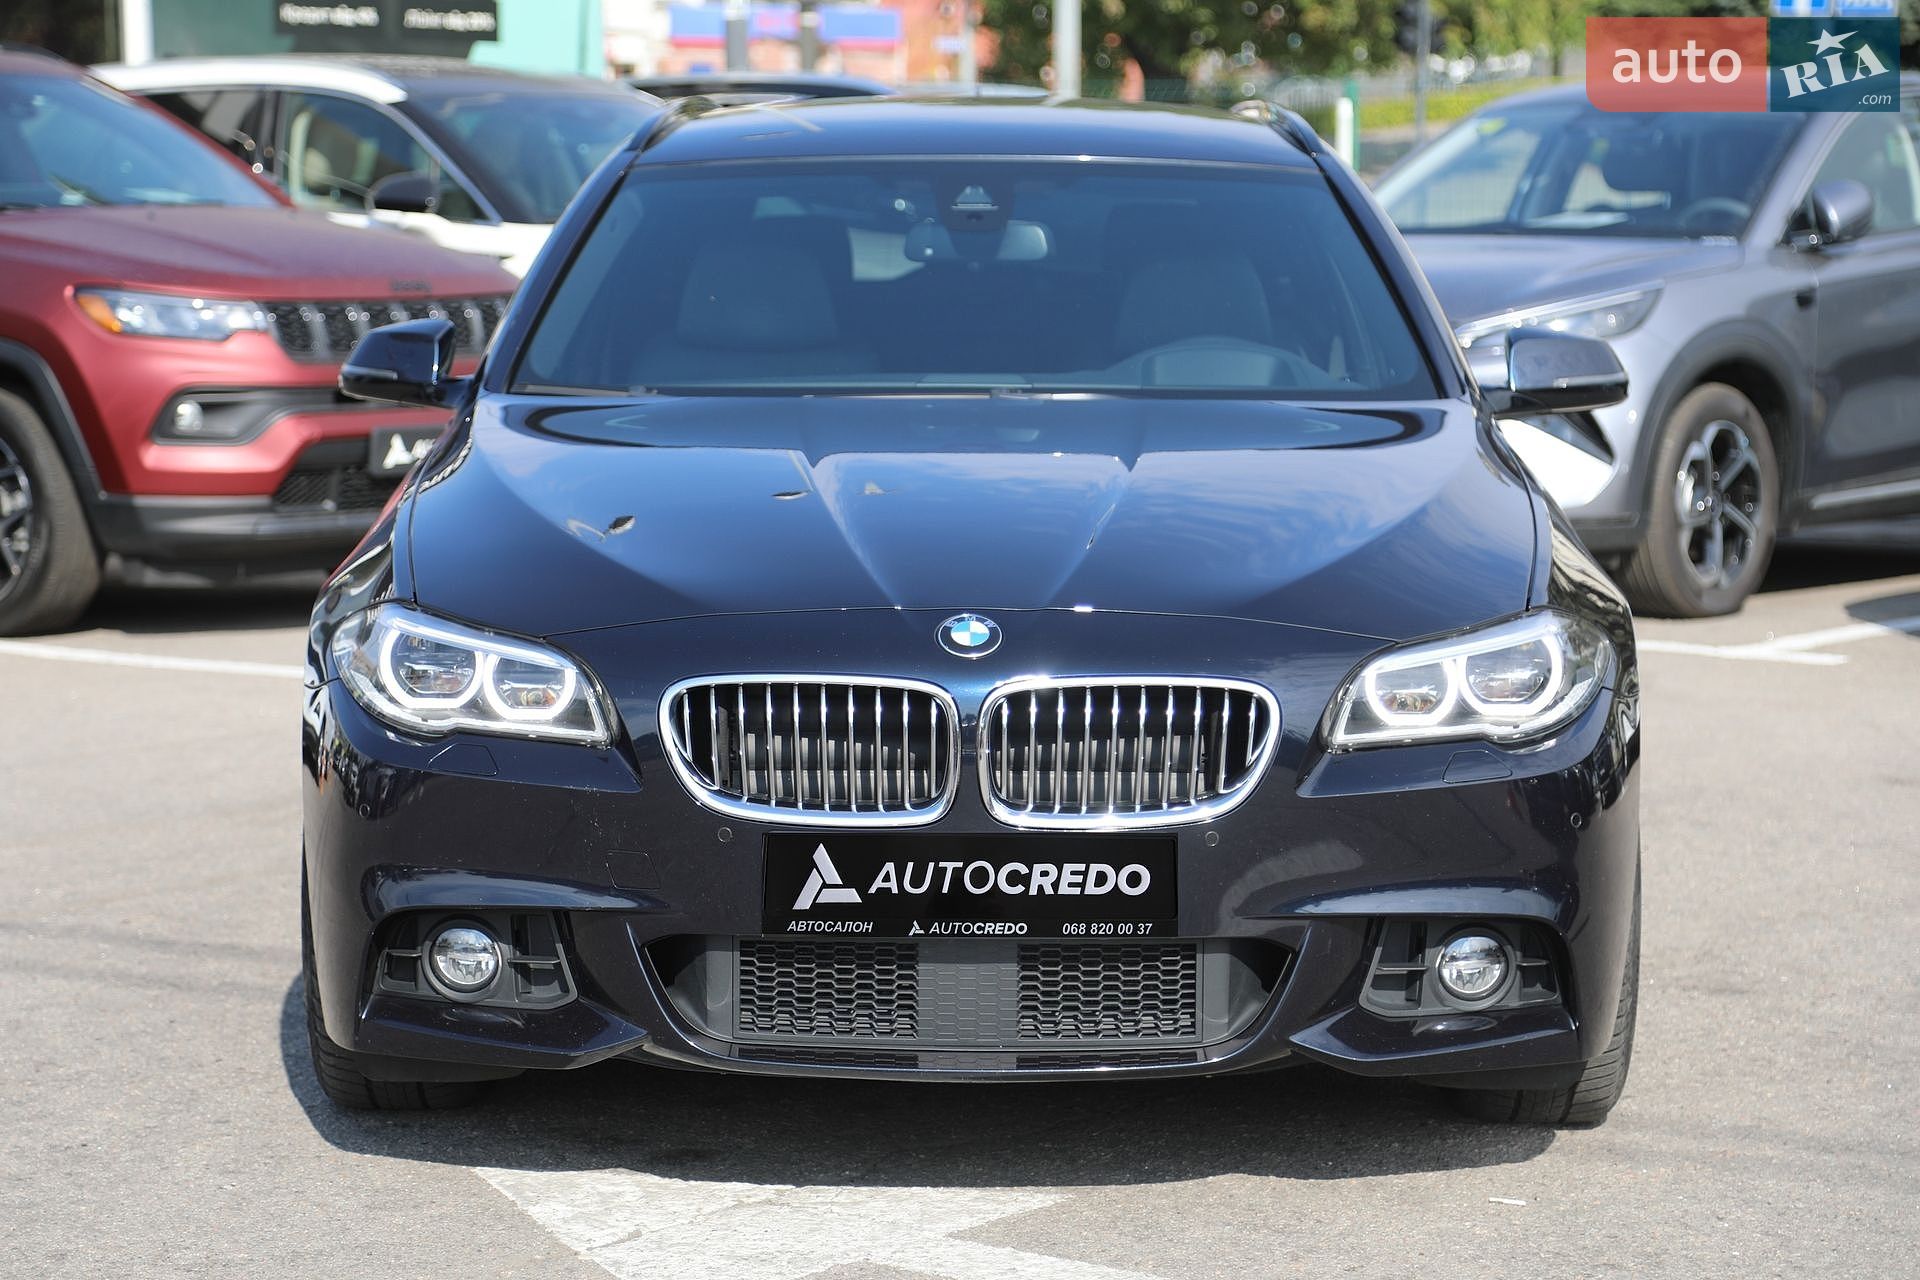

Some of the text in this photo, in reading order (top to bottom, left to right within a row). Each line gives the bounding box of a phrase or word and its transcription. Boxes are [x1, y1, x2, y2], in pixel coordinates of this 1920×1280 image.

[868, 860, 1151, 896] AUTOCREDO
[787, 920, 873, 933] АВТОСАЛОН
[929, 922, 1028, 935] AUTOCREDO
[1062, 923, 1152, 935] 068 820 00 37
